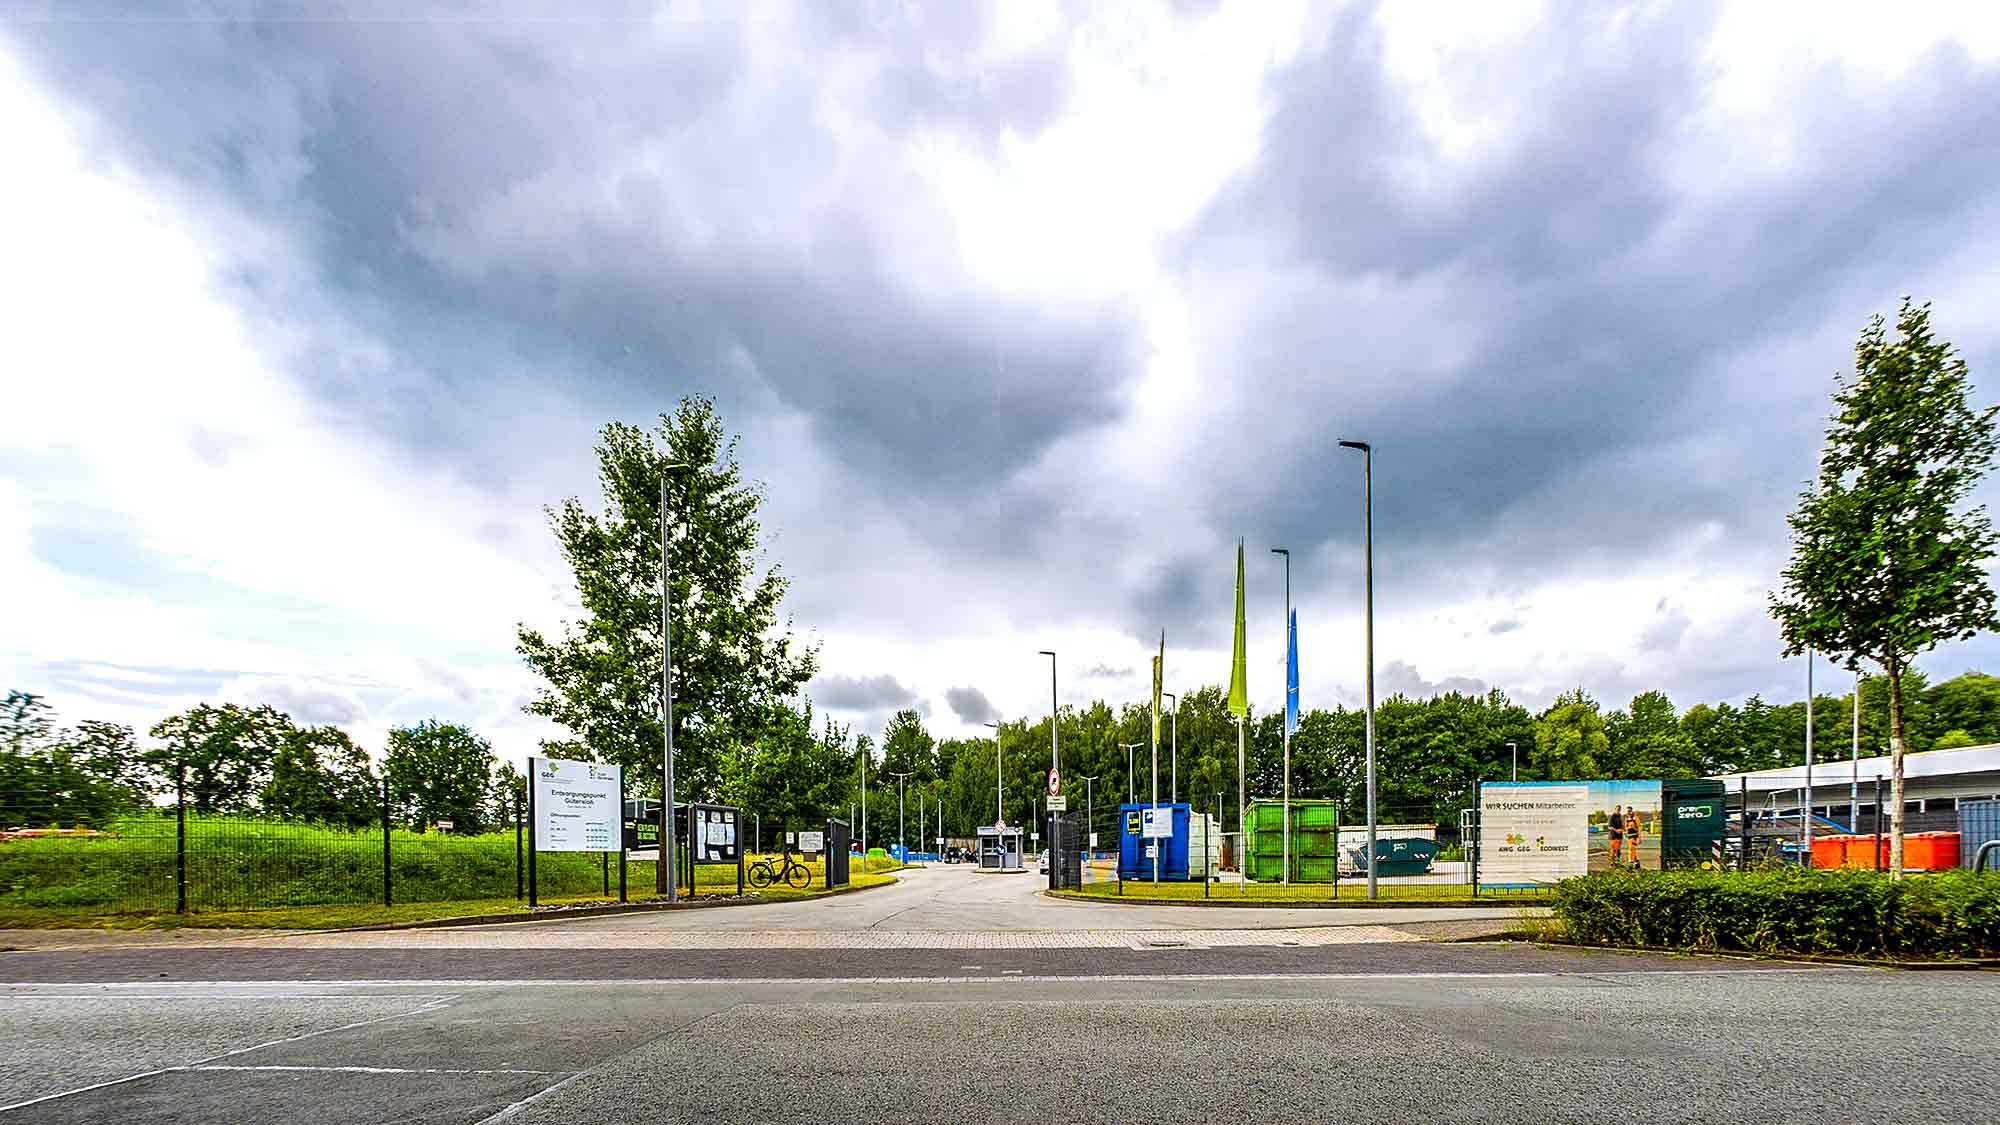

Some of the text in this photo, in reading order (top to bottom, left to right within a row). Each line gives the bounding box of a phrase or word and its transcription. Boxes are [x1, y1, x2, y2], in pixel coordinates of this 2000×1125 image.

[551, 789, 606, 798] Entsorgungspunkt
[1485, 802, 1501, 810] WIR
[1502, 802, 1534, 810] SUCHEN
